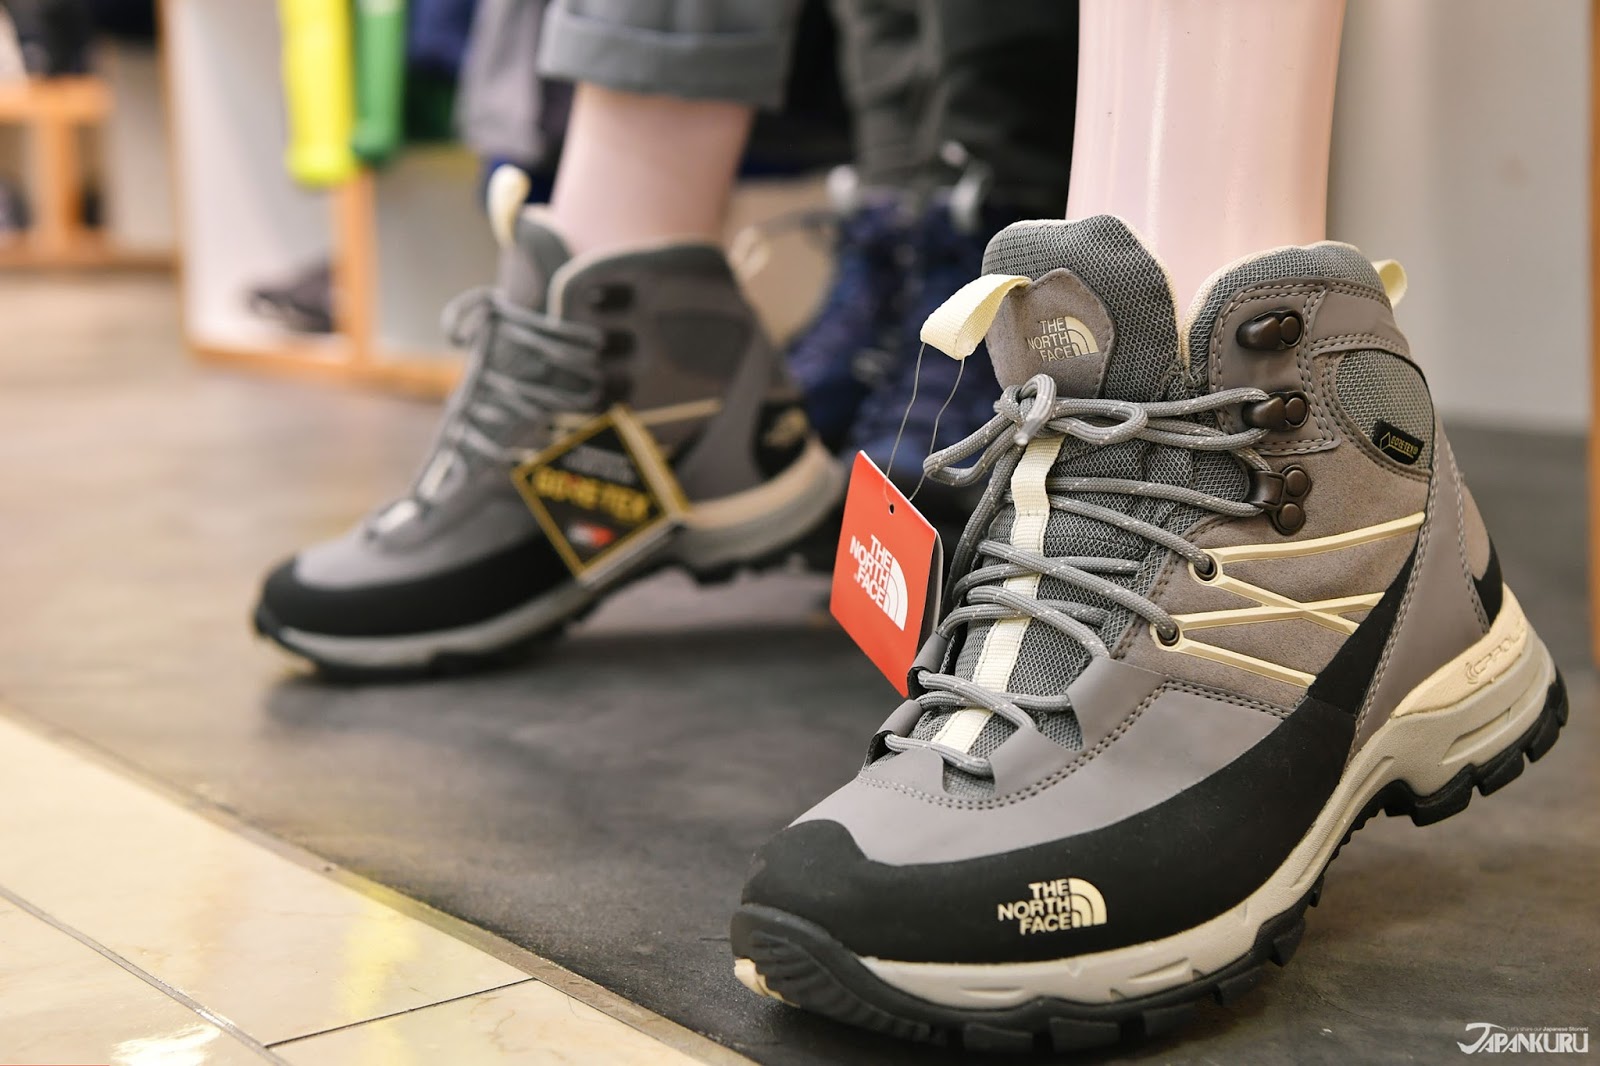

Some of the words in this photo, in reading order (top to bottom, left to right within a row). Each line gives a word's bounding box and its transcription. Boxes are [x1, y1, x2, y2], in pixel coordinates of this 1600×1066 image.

[1040, 317, 1066, 334] THE
[1026, 331, 1070, 350] NORTH
[1040, 345, 1075, 362] FACE
[849, 535, 890, 591] NORTH
[871, 534, 893, 572] THE
[856, 565, 885, 609] FACE
[1028, 878, 1069, 899] THE
[996, 896, 1071, 922] NORTH
[1019, 912, 1072, 936] FACE
